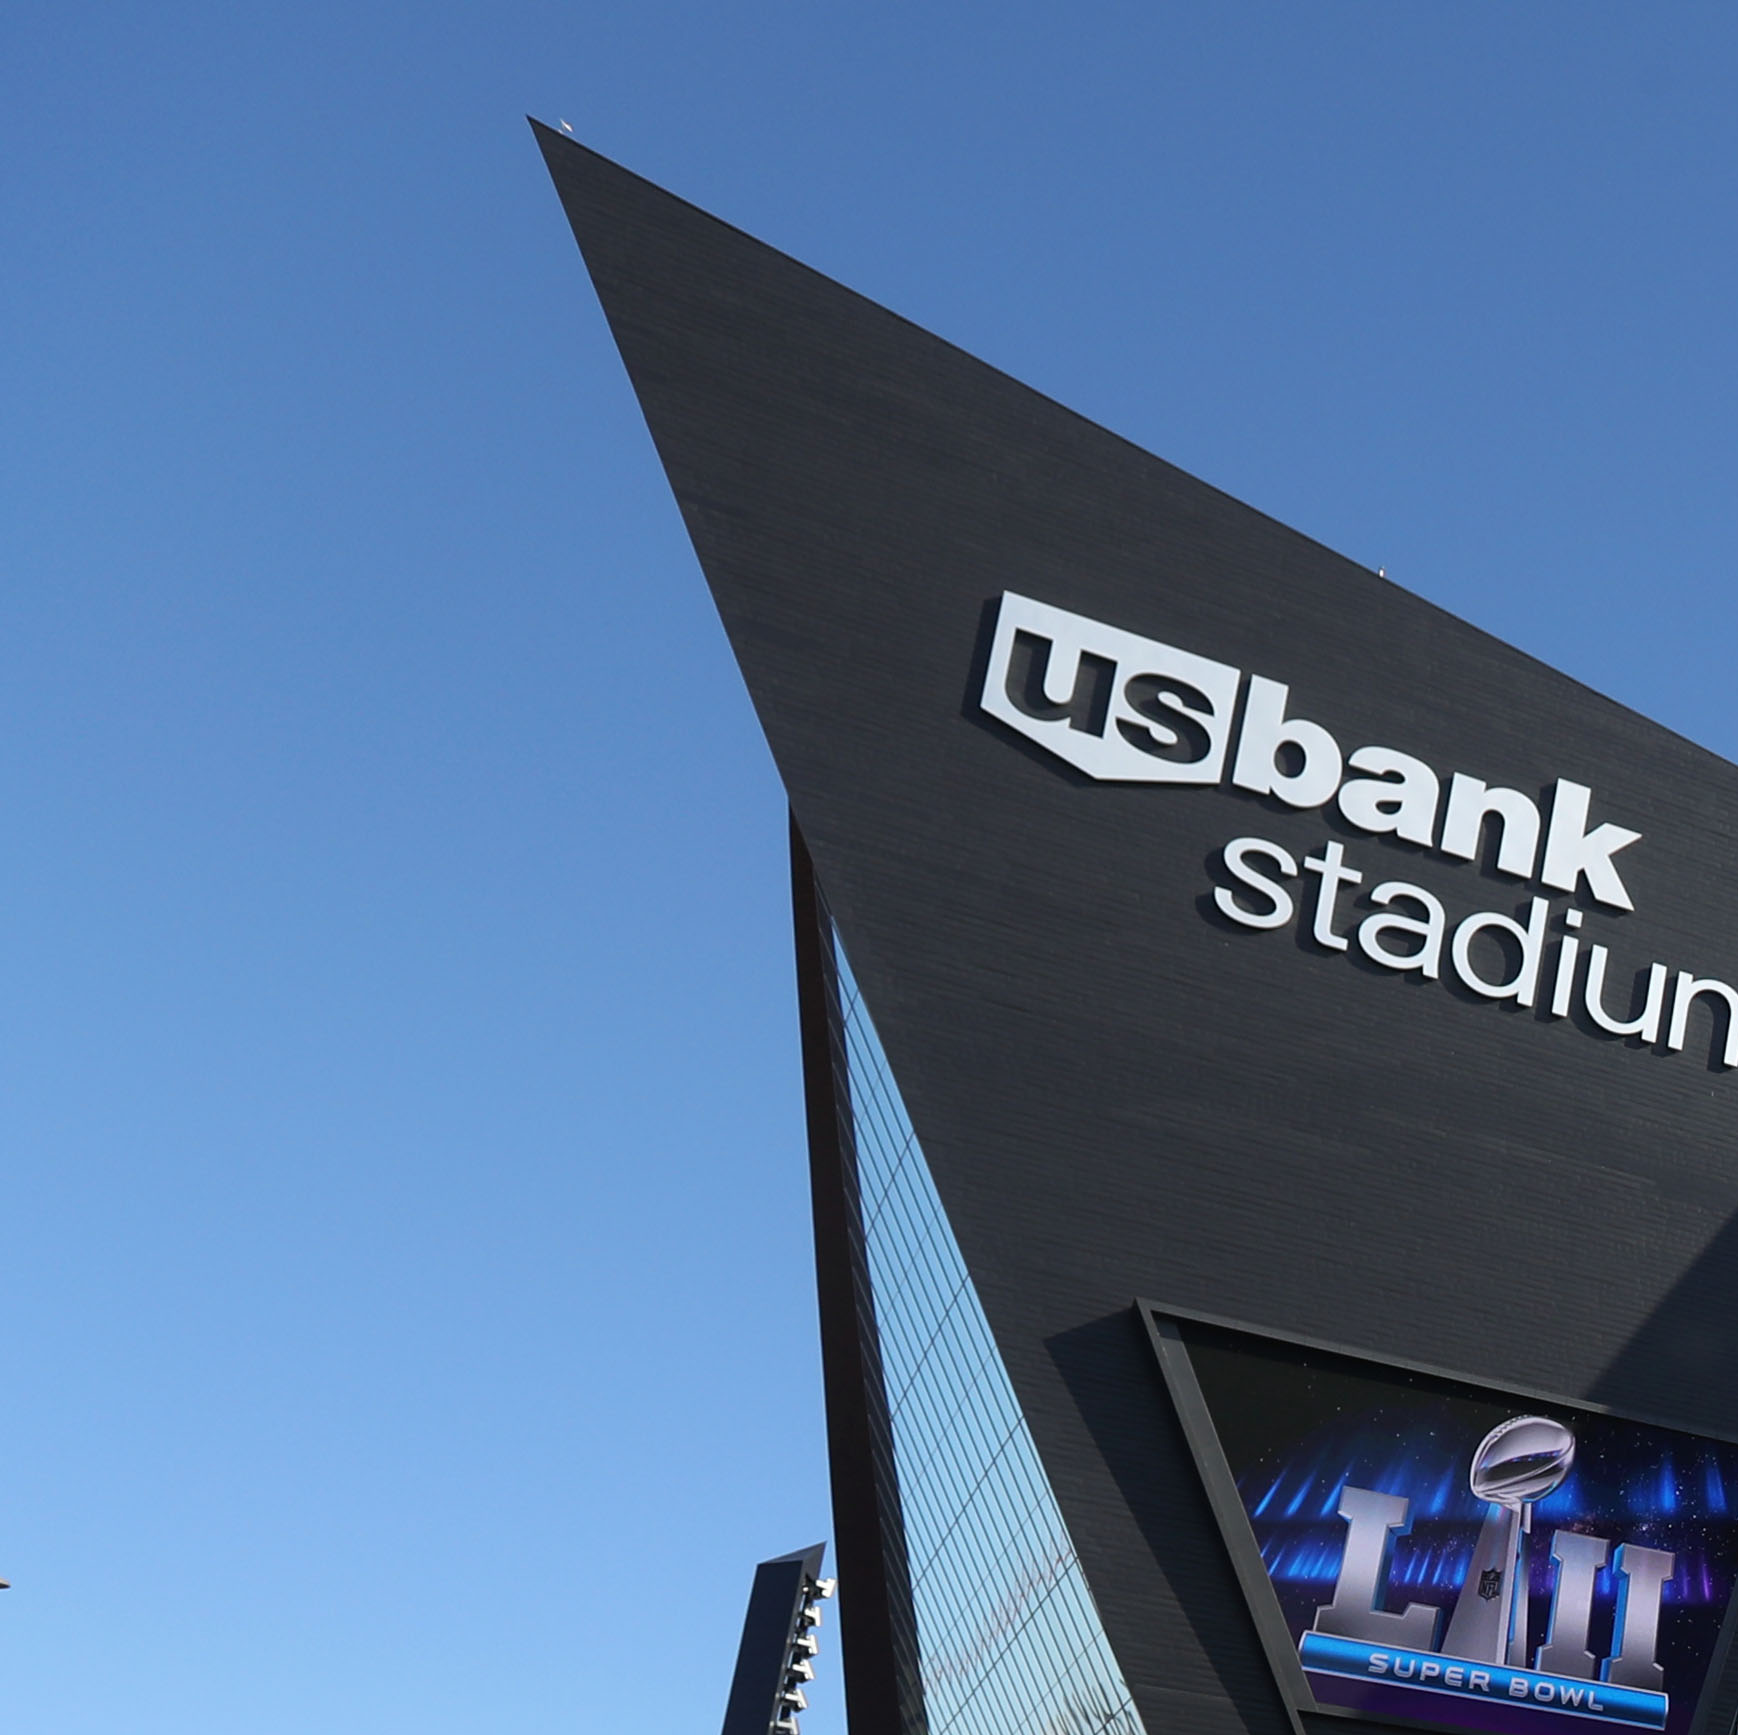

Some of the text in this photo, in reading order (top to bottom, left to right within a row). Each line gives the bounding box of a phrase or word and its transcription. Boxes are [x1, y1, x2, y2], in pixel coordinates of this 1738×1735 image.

[1312, 1485, 1675, 1692] LII
[1367, 1651, 1605, 1713] SUPER BOWL
